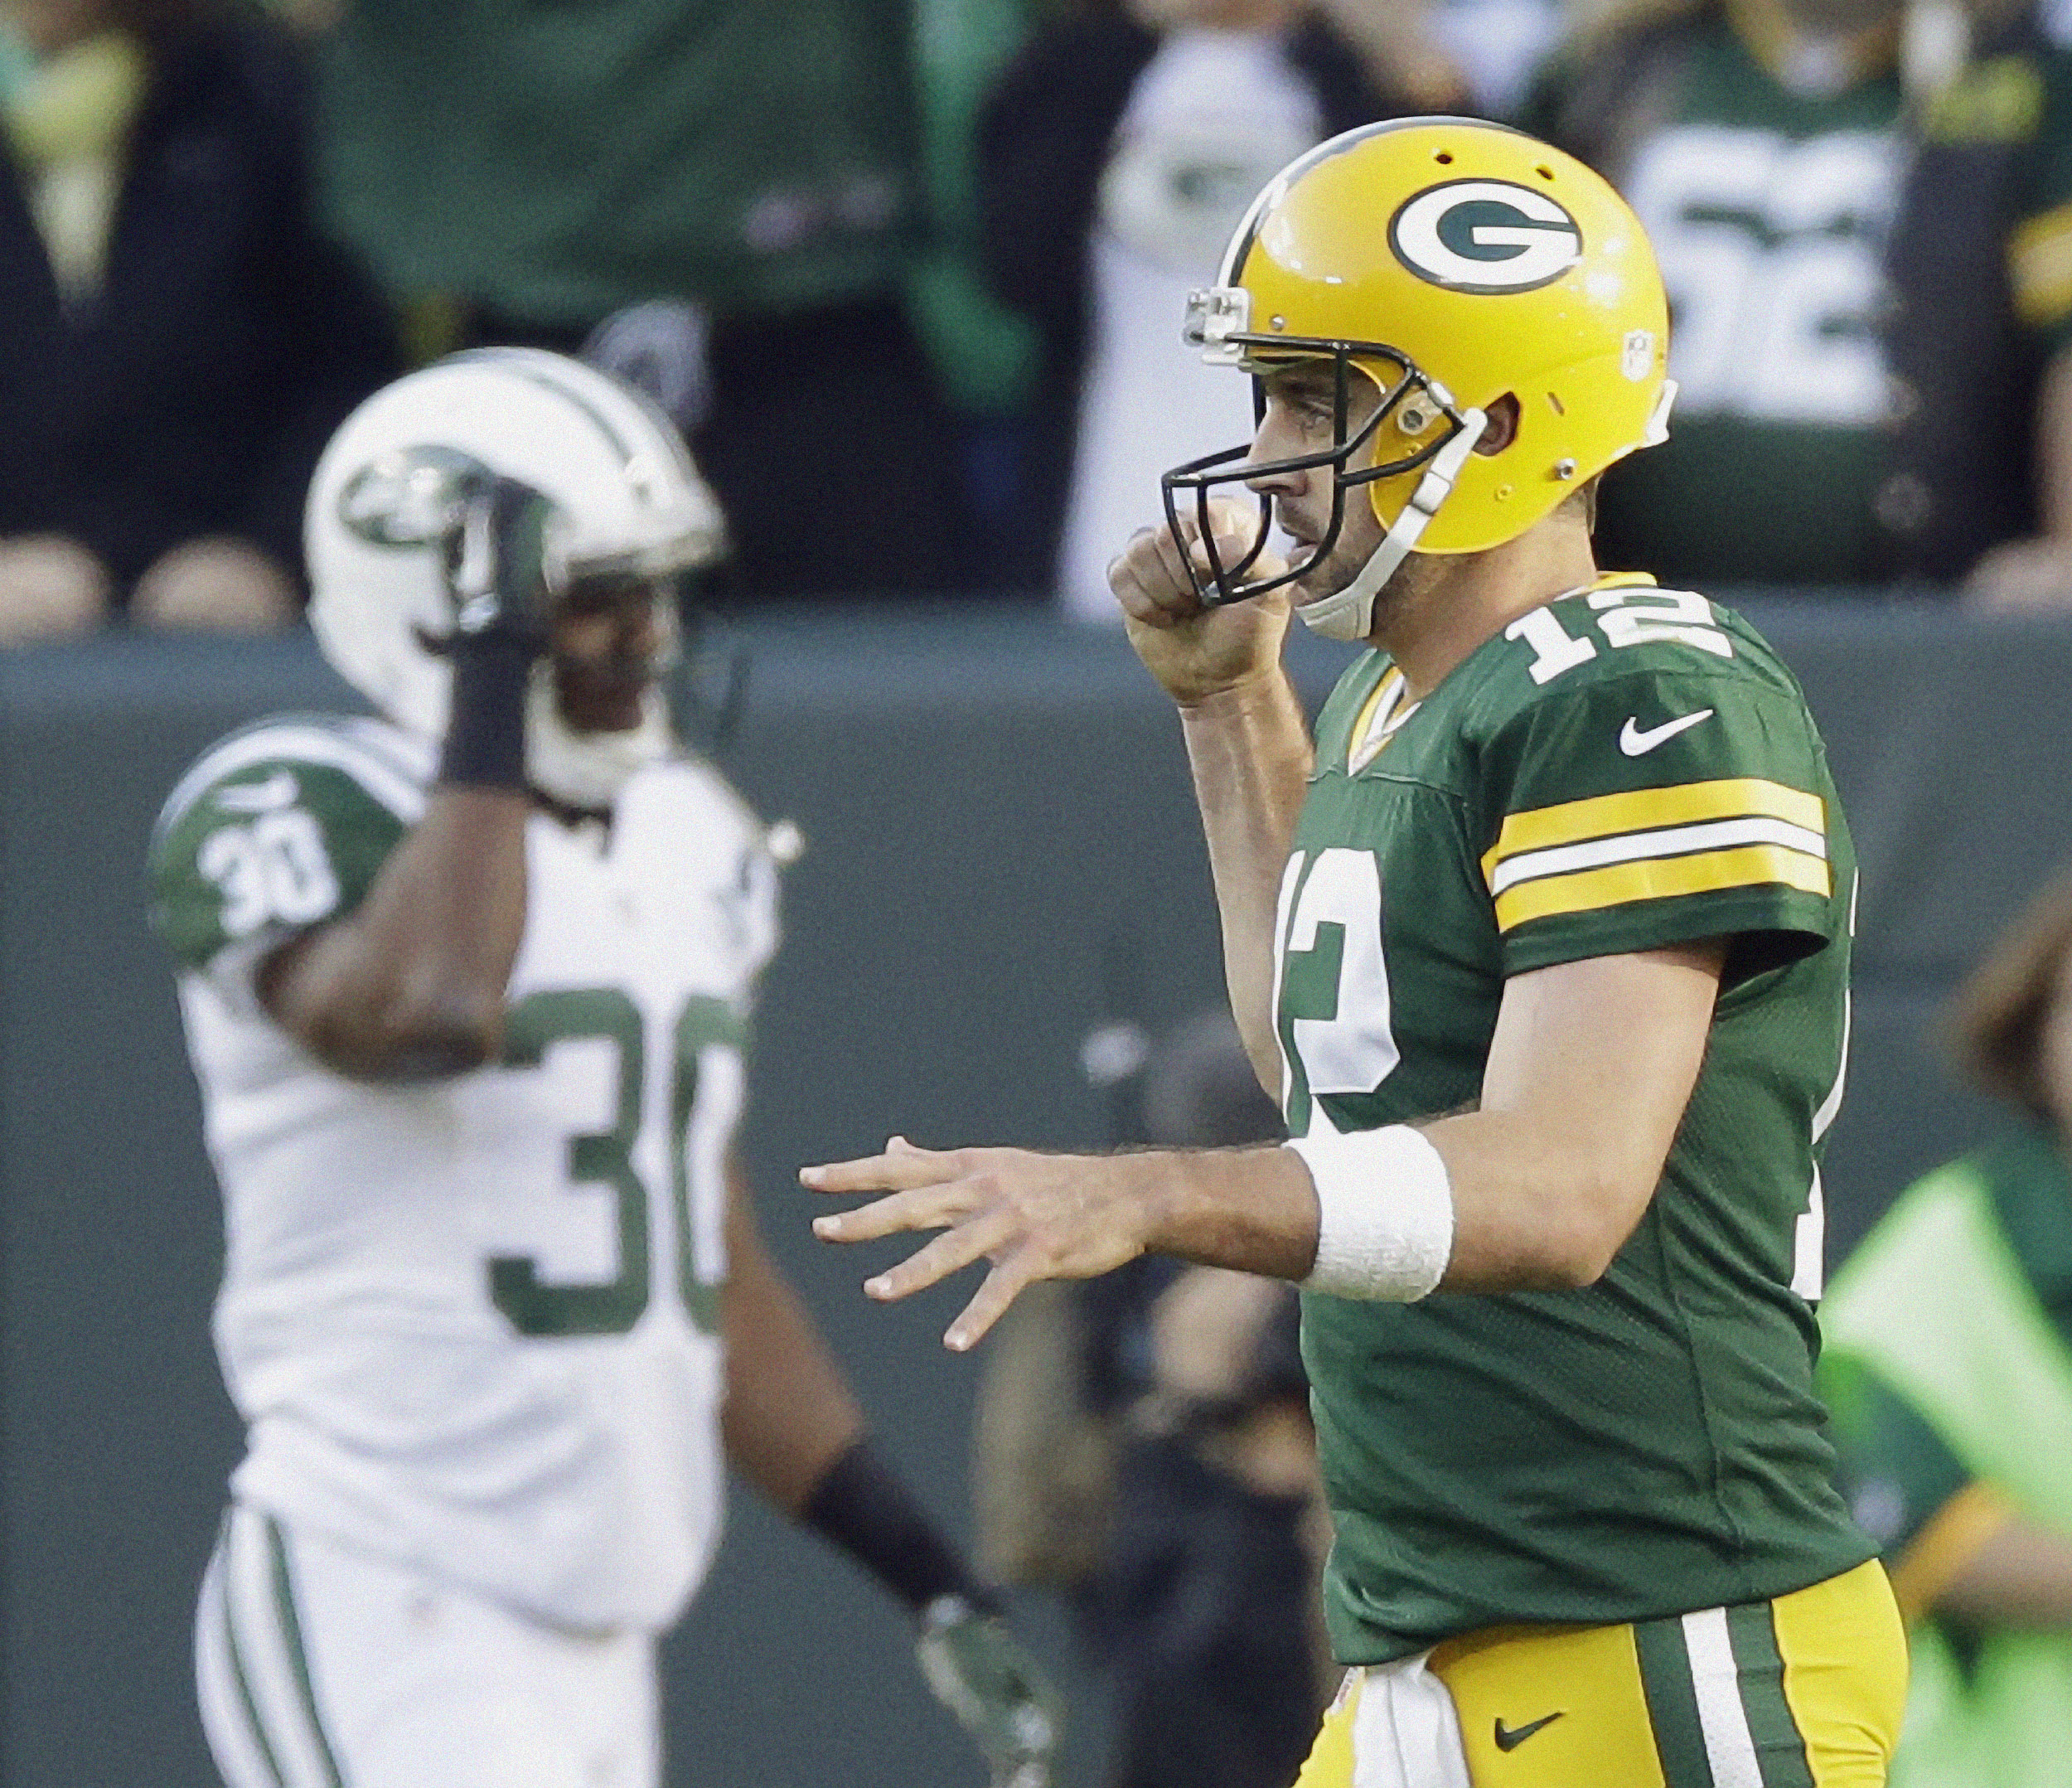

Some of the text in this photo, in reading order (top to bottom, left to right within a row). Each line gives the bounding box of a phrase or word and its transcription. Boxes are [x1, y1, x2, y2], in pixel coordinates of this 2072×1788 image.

[1397, 182, 1578, 287] G
[1504, 588, 1734, 686] 12
[197, 808, 342, 937] 30
